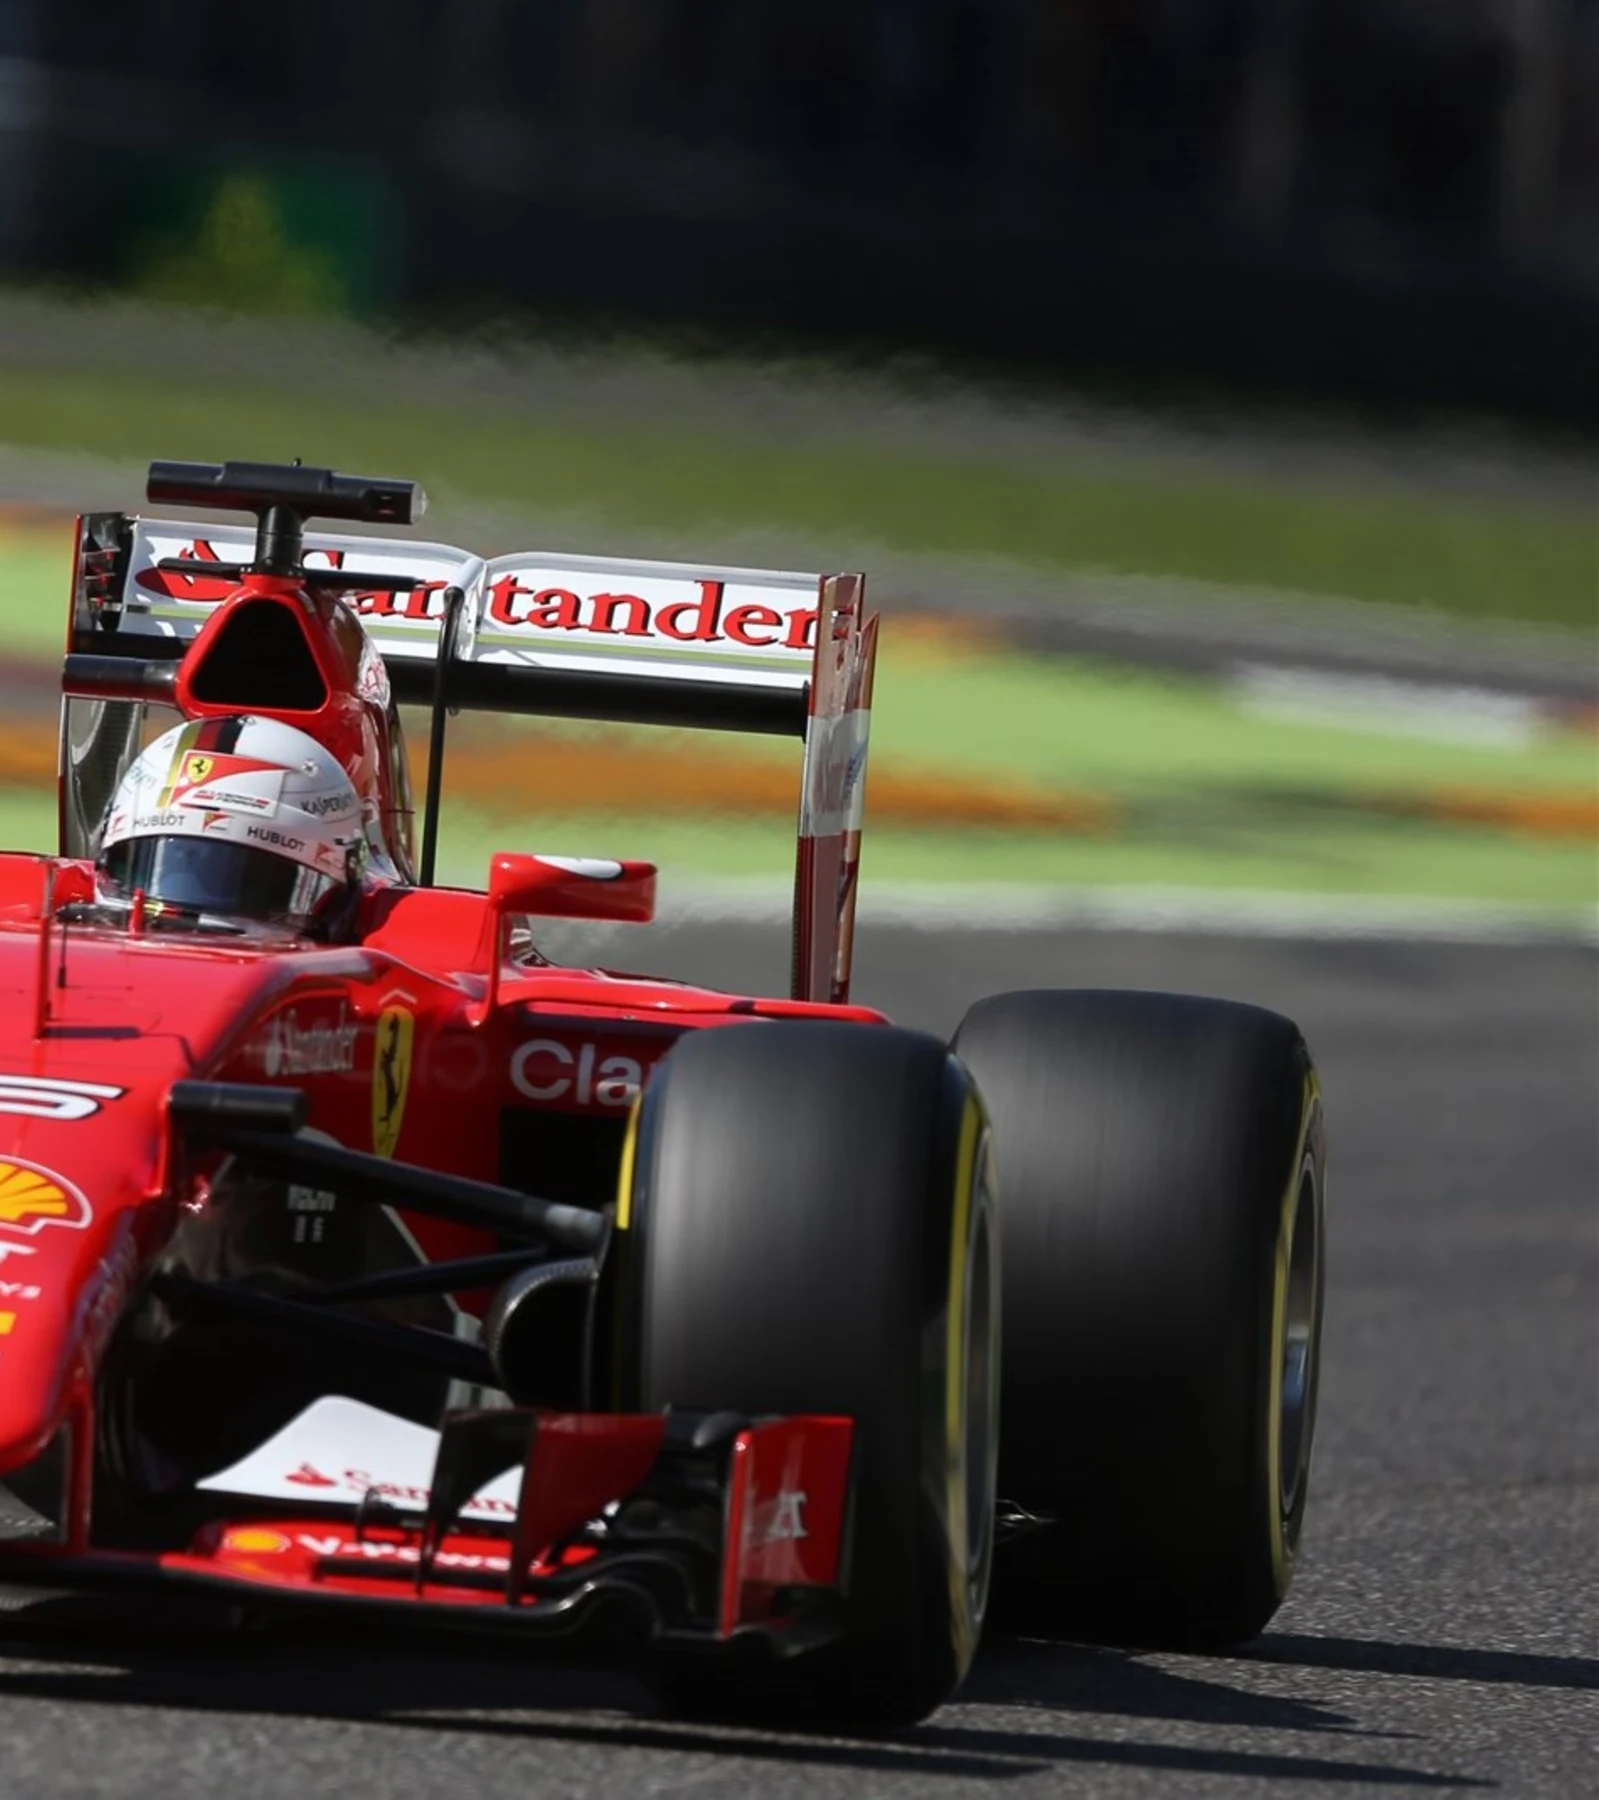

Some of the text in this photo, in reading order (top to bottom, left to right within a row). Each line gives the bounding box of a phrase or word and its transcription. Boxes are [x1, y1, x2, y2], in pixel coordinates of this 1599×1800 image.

[133, 813, 186, 829] HUBLOT
[247, 825, 306, 852] HUBLOT
[510, 1038, 656, 1106] Cla
[297, 1533, 542, 1574] V-Powe
